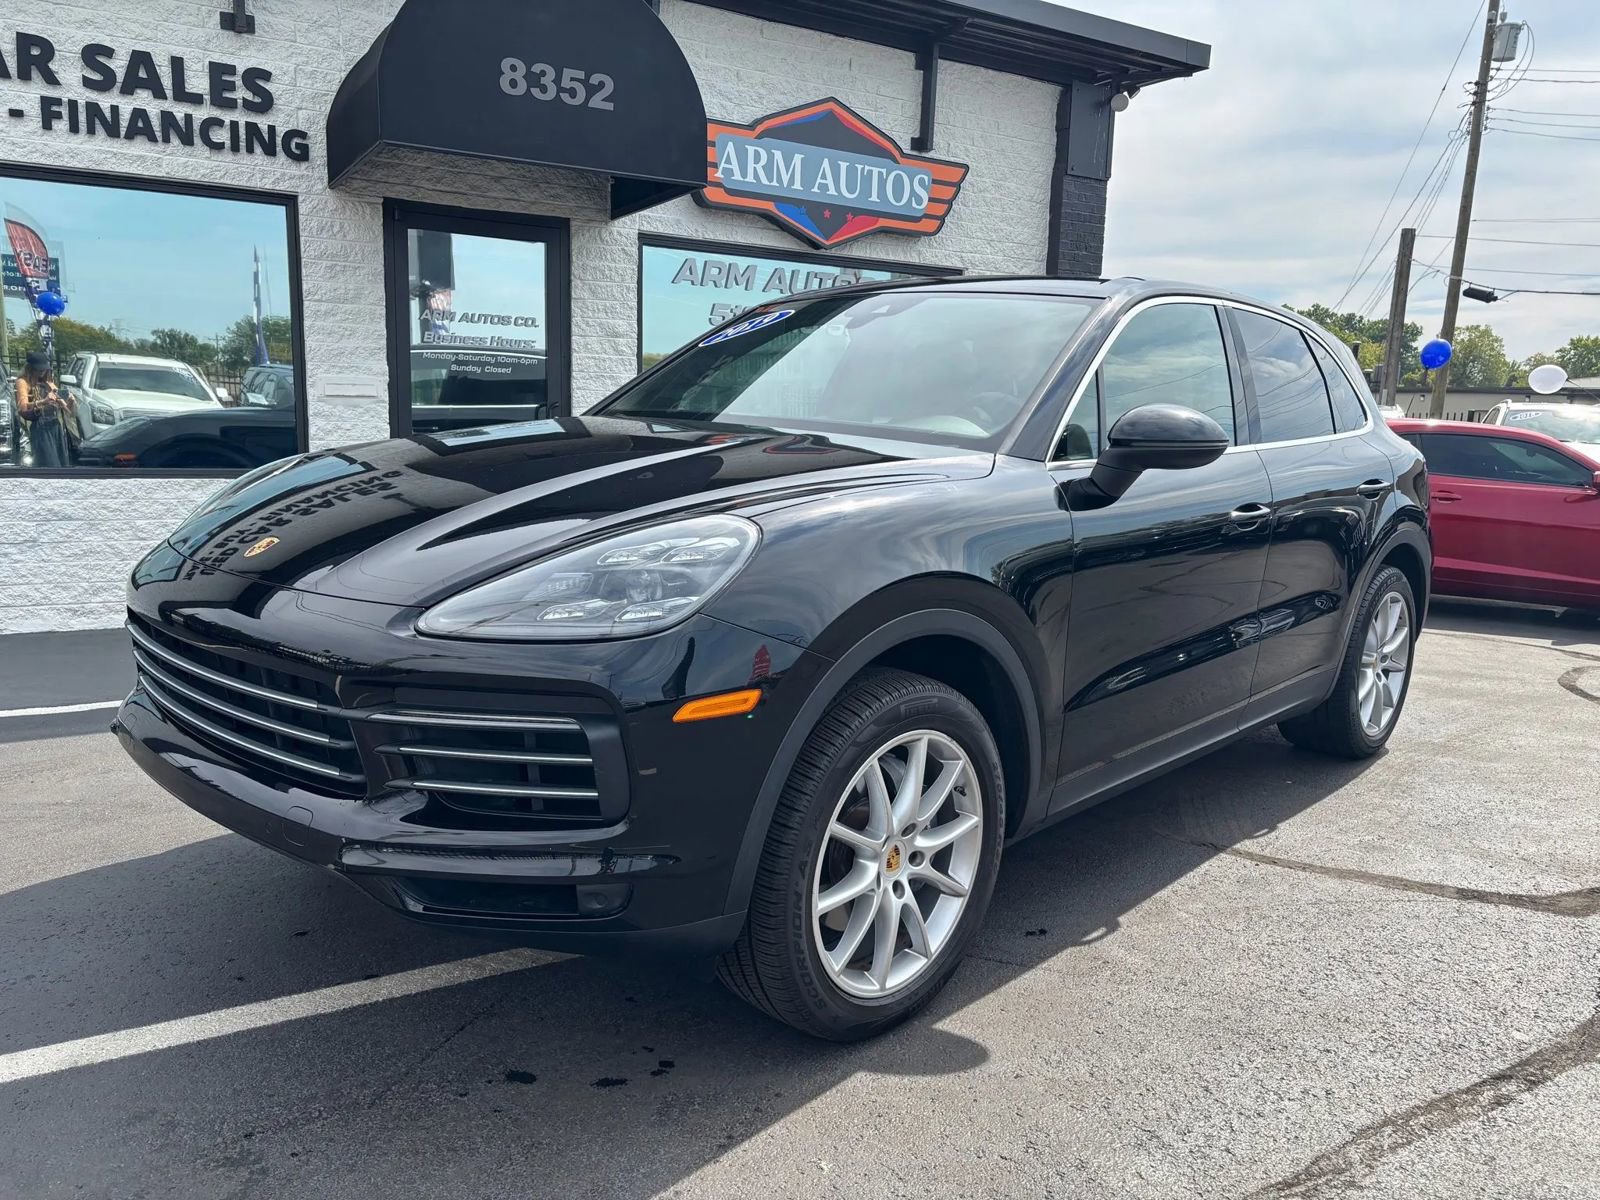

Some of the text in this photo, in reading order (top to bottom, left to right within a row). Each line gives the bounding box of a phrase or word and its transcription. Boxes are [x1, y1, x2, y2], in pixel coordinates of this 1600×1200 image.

[0, 31, 274, 113] R SALES
[499, 57, 614, 111] 8352
[40, 95, 310, 162] FINANCING
[714, 140, 930, 210] ARM AUTOS
[671, 258, 758, 291] ARM
[419, 309, 540, 328] ARM AUTOS CO.
[422, 331, 536, 349] Business Hours:
[423, 352, 538, 367] Monday-Saturday 10am-6pm
[450, 364, 512, 374] Sunday Closed
